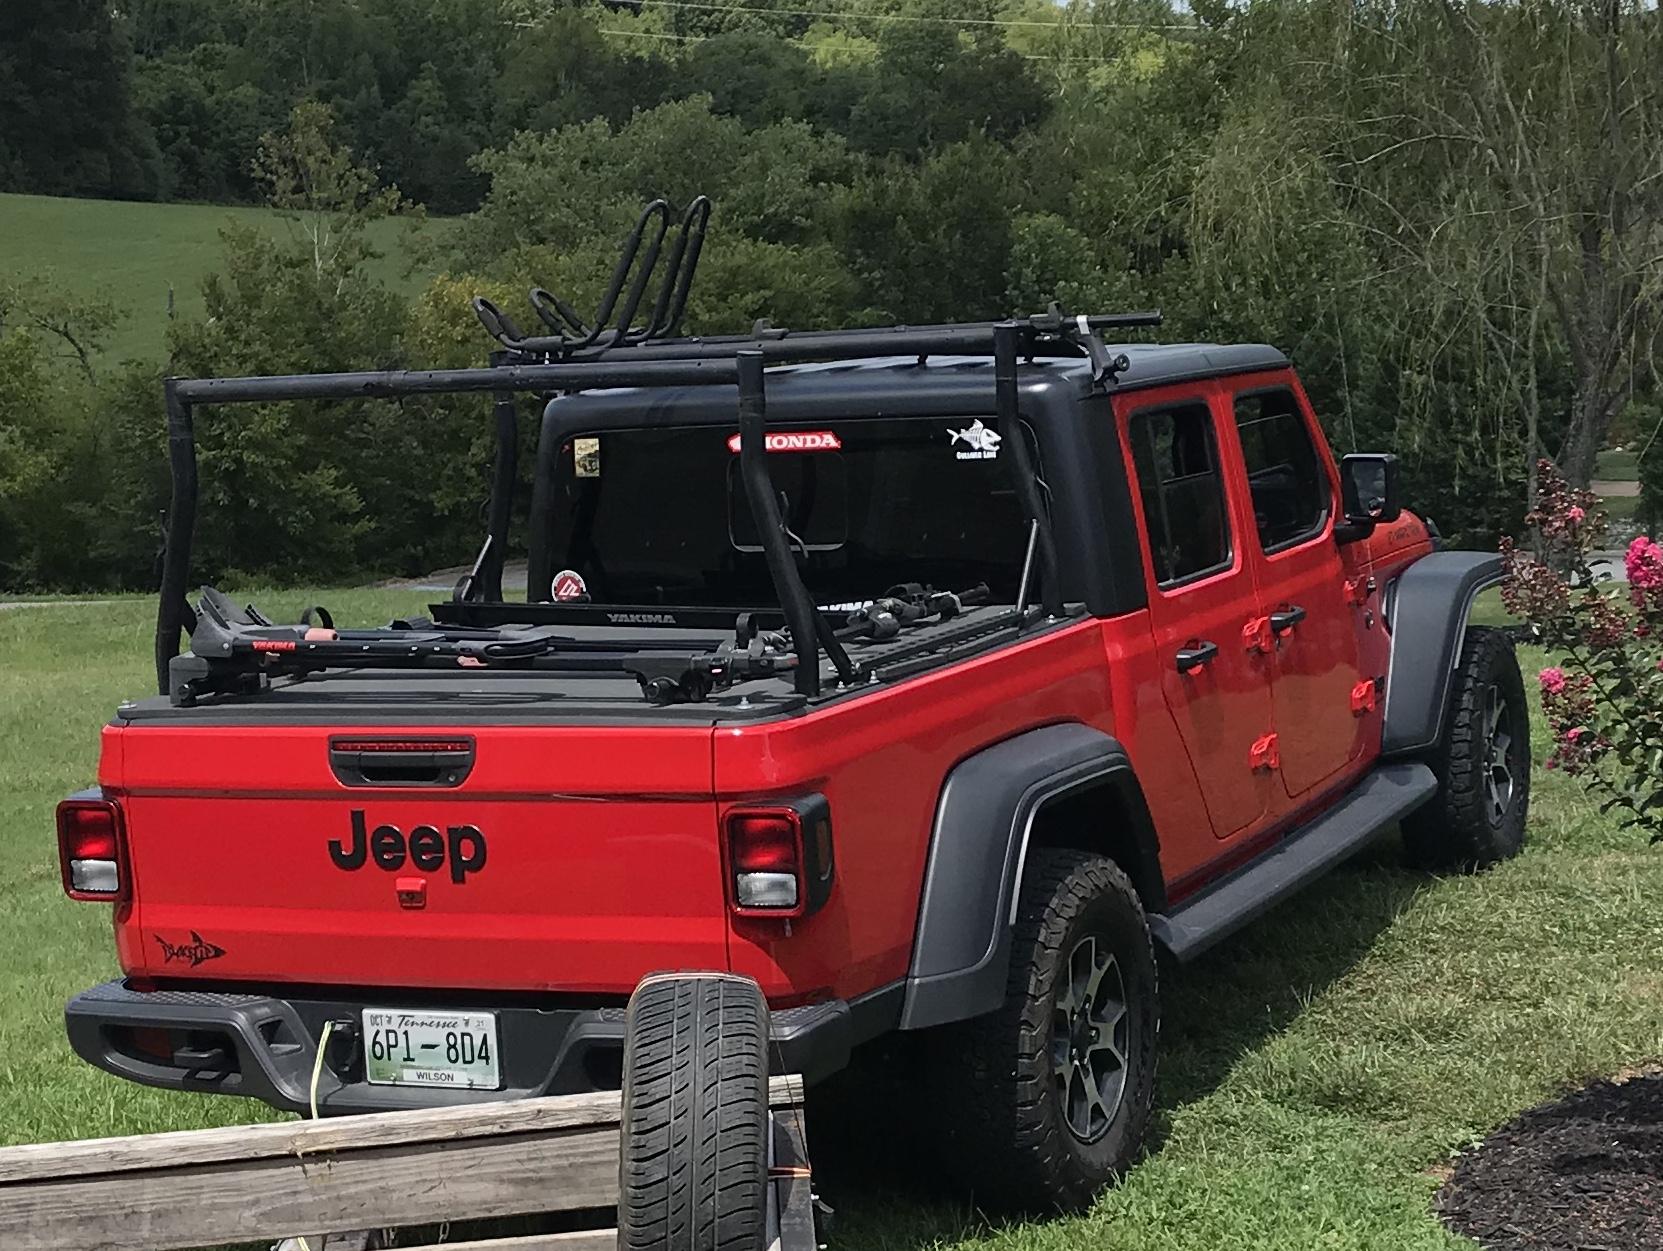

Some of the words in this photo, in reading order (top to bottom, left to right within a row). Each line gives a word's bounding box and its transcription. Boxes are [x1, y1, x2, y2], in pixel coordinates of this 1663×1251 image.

[607, 613, 676, 624] YAKIMA
[252, 641, 296, 650] YAKIMA
[328, 809, 487, 885] Jeep
[398, 1015, 459, 1029] Tennessee
[416, 1072, 454, 1082] WILSON
